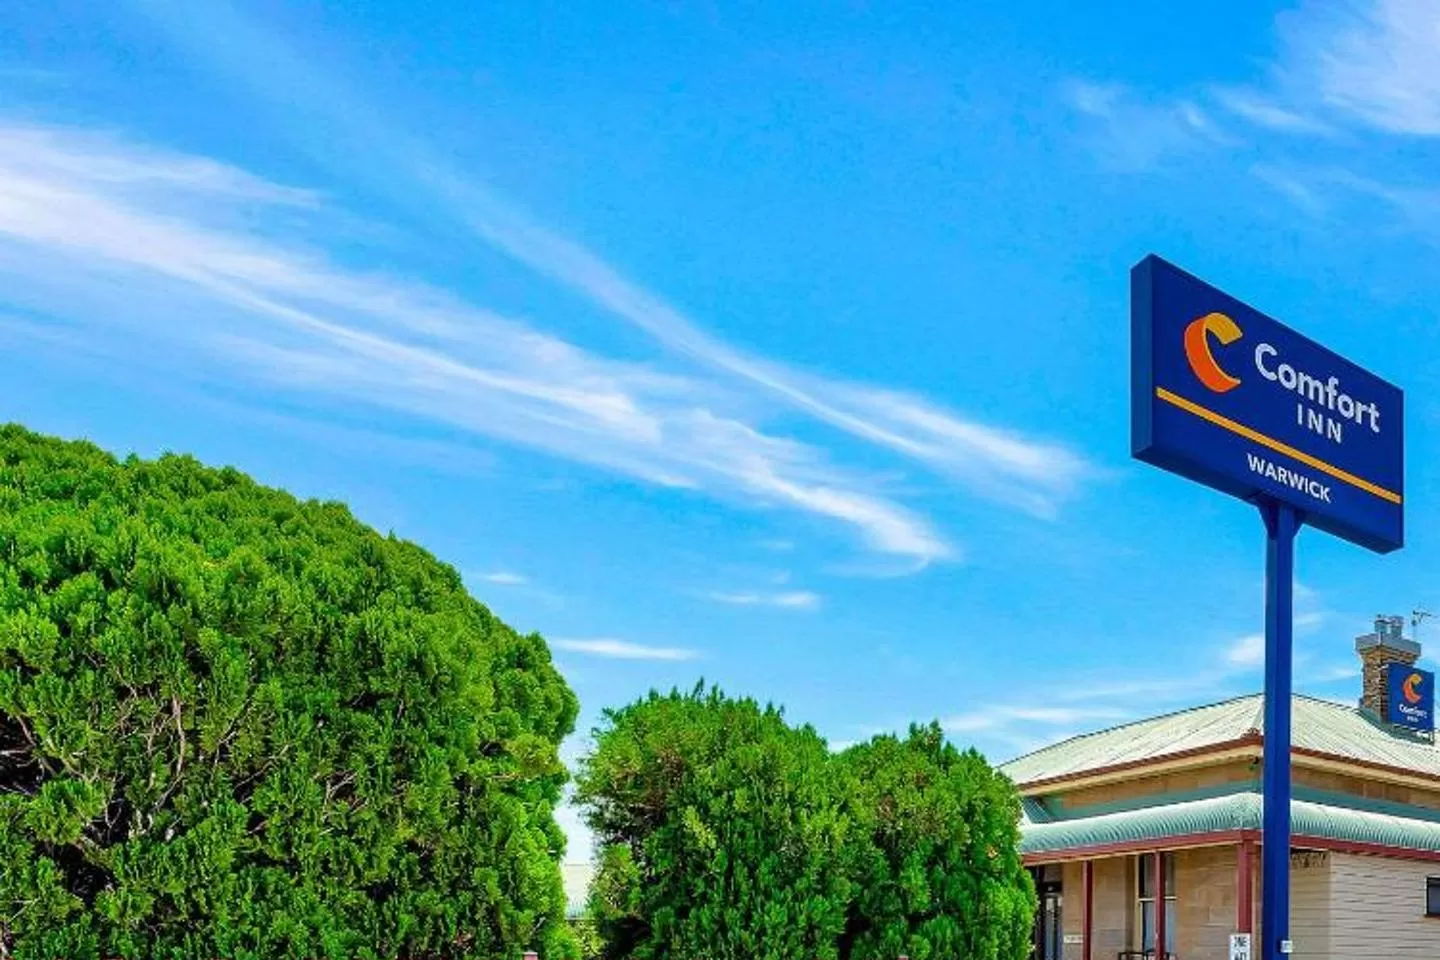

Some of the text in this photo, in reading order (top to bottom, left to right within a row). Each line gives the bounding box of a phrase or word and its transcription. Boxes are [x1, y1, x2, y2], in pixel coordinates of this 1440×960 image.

[1254, 343, 1381, 433] Comfort
[1296, 403, 1343, 445] INN
[1246, 452, 1332, 504] WARWICK
